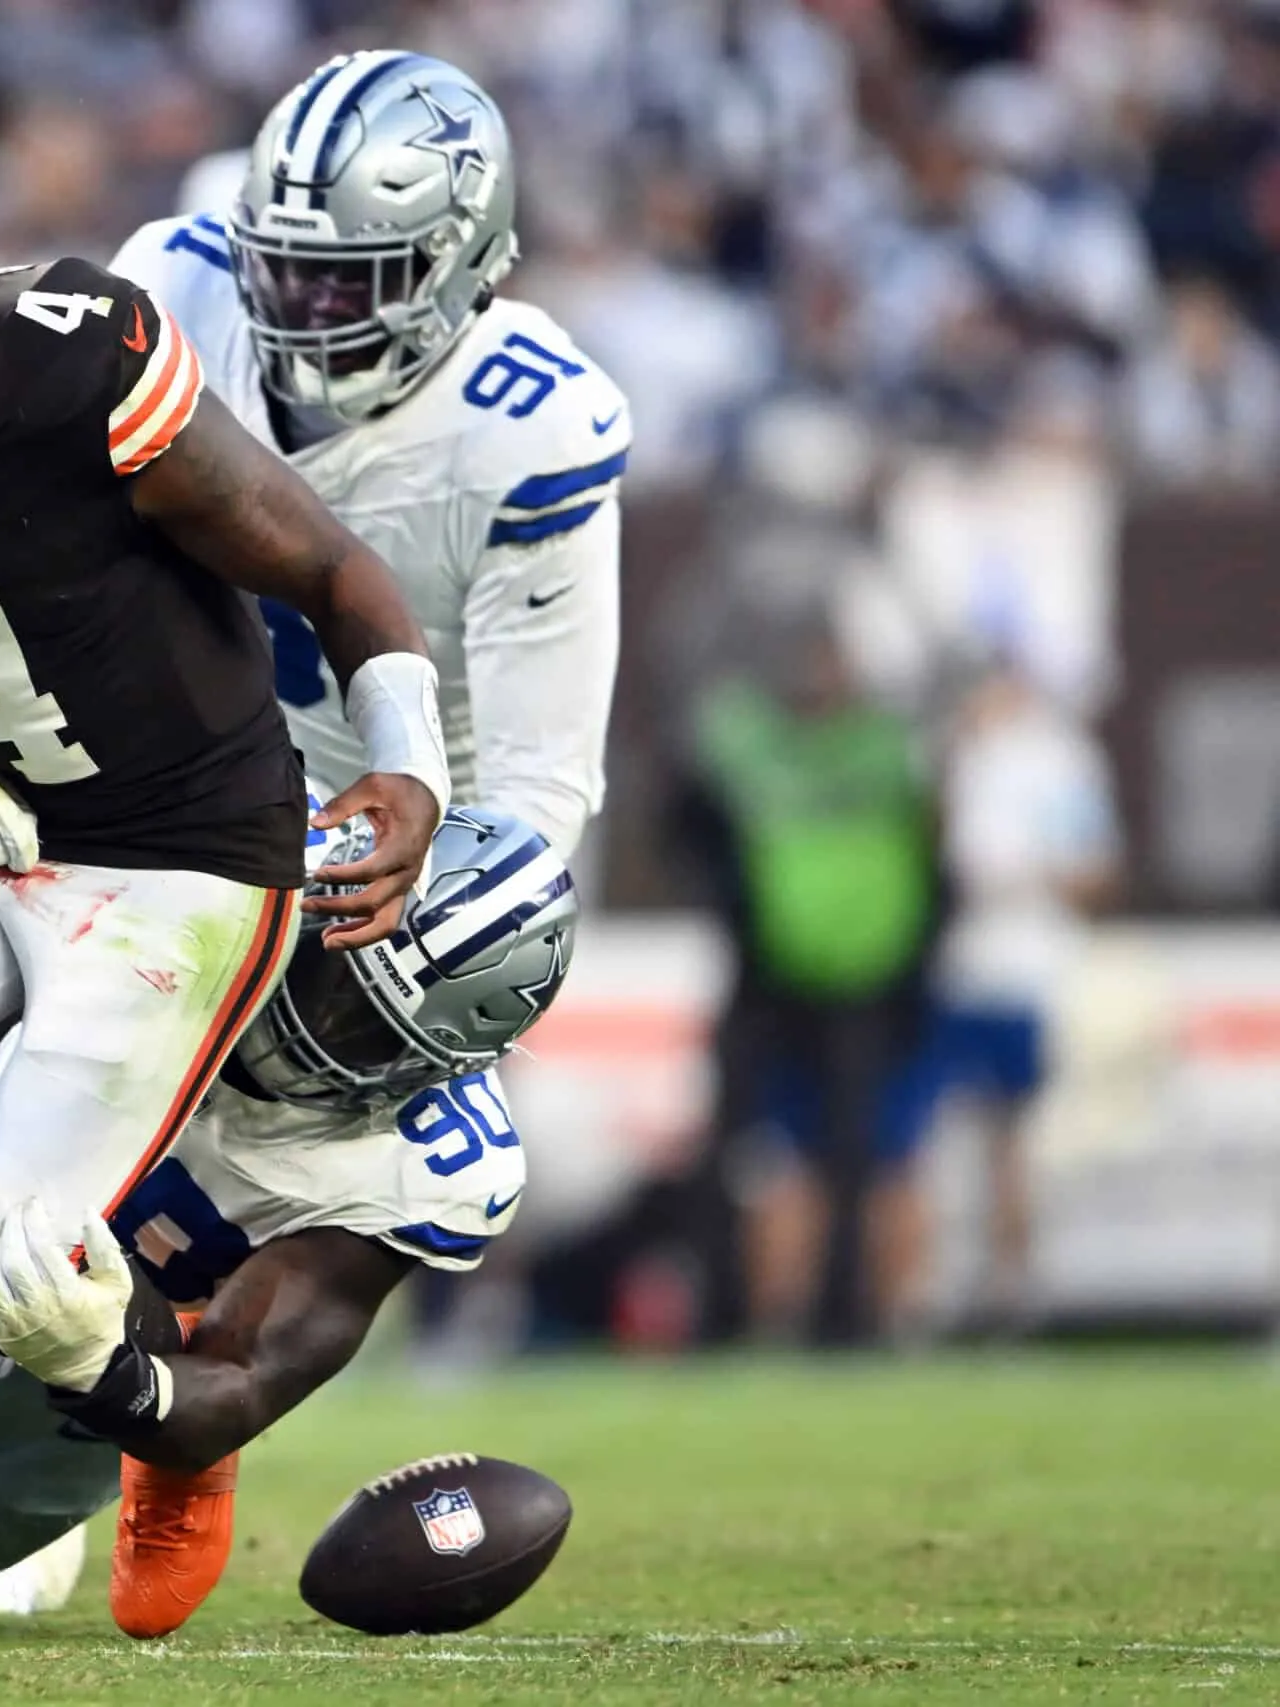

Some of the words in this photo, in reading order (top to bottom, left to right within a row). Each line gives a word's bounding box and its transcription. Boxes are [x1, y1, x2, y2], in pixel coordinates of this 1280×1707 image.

[15, 289, 114, 335] 4
[462, 332, 587, 420] 91
[374, 945, 415, 999] COWBOYS
[395, 1070, 521, 1177] 90
